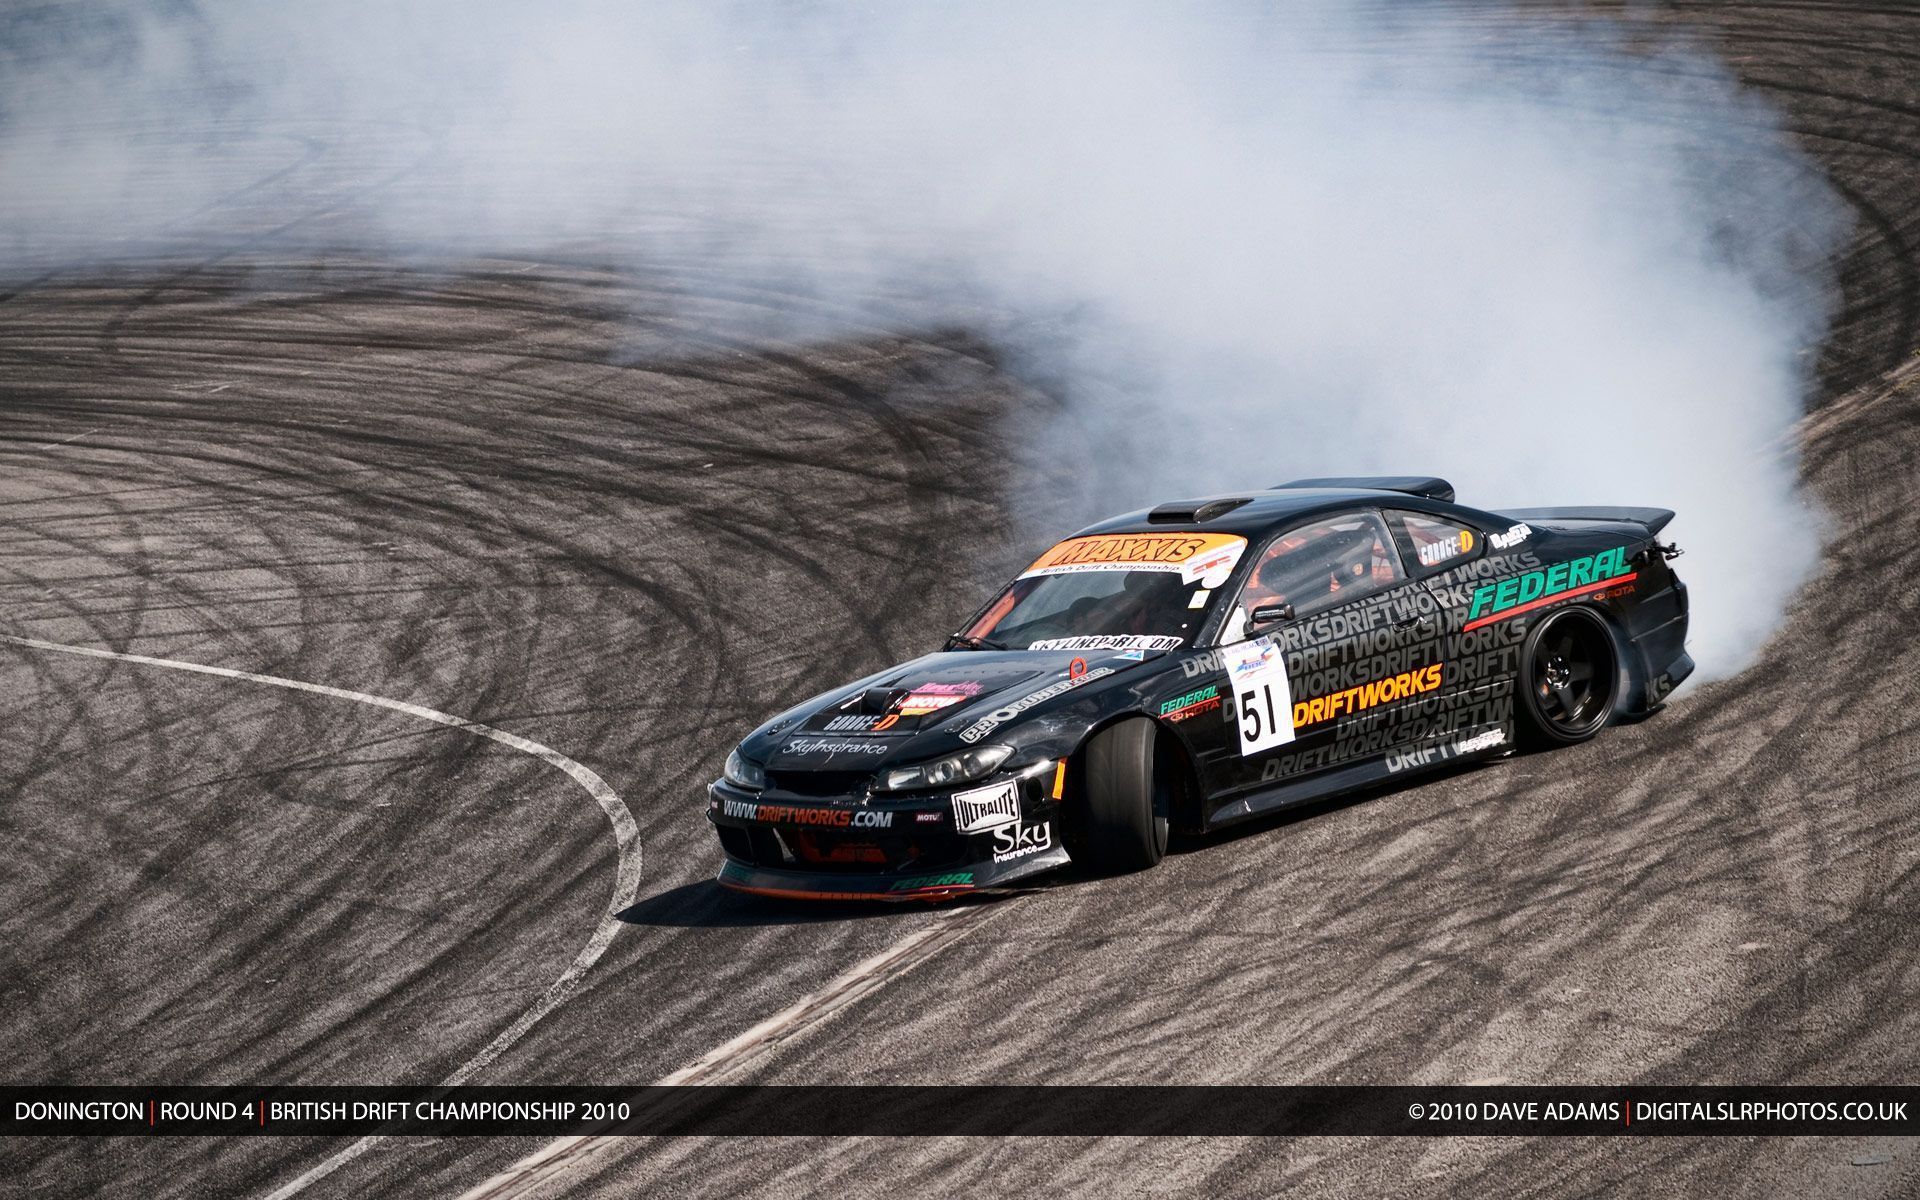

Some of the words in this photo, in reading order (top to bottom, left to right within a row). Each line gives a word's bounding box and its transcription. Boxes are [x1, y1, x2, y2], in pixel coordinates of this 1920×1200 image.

[1048, 538, 1206, 567] MAXXIS
[1420, 530, 1474, 566] GARAGE-D
[1041, 566, 1073, 575] British
[1076, 564, 1101, 572] Drift
[1103, 564, 1180, 573] Championship
[1468, 546, 1632, 620] FEDERAL
[1160, 685, 1218, 715] FEDERAL
[1294, 663, 1443, 729] DRIFTWORKS
[823, 714, 900, 731] GARAGE-D
[1241, 684, 1276, 742] 51
[724, 800, 893, 828] WWW.DRIFTWORKS.COM
[959, 787, 1017, 828] ULTRALITE
[993, 821, 1052, 854] Sky
[994, 845, 1038, 864] Insurance
[890, 872, 973, 890] FEDERAL
